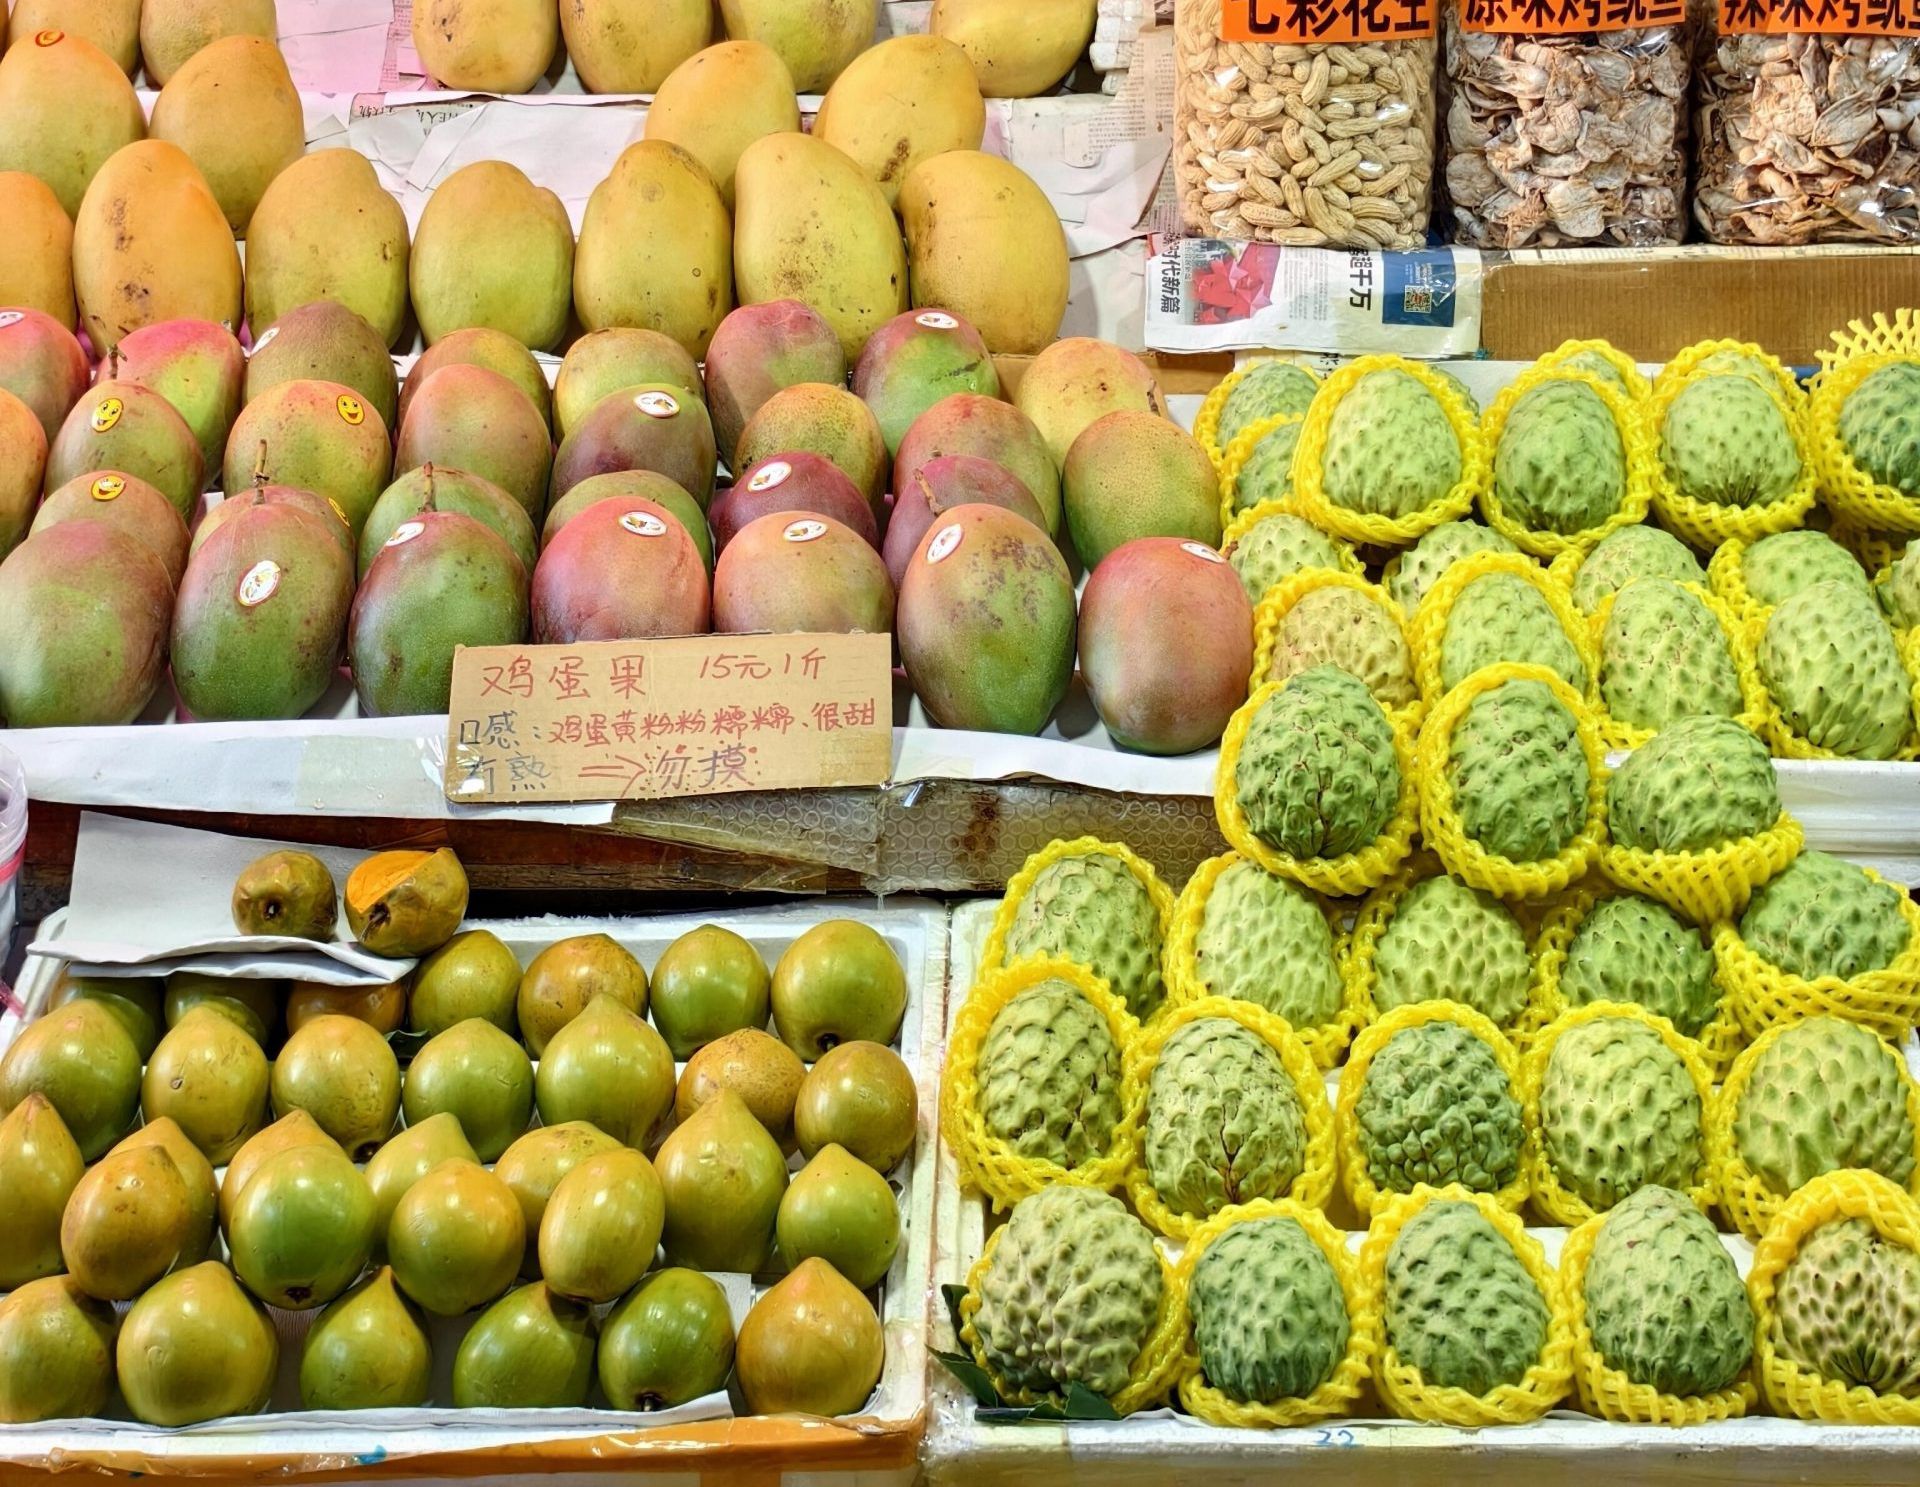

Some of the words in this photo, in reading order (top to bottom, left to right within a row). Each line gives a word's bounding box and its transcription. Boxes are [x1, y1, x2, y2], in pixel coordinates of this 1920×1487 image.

[1160, 232, 1182, 314] 时代新篇
[480, 654, 647, 701] 鸡蛋果
[656, 743, 755, 790] 勿摸
